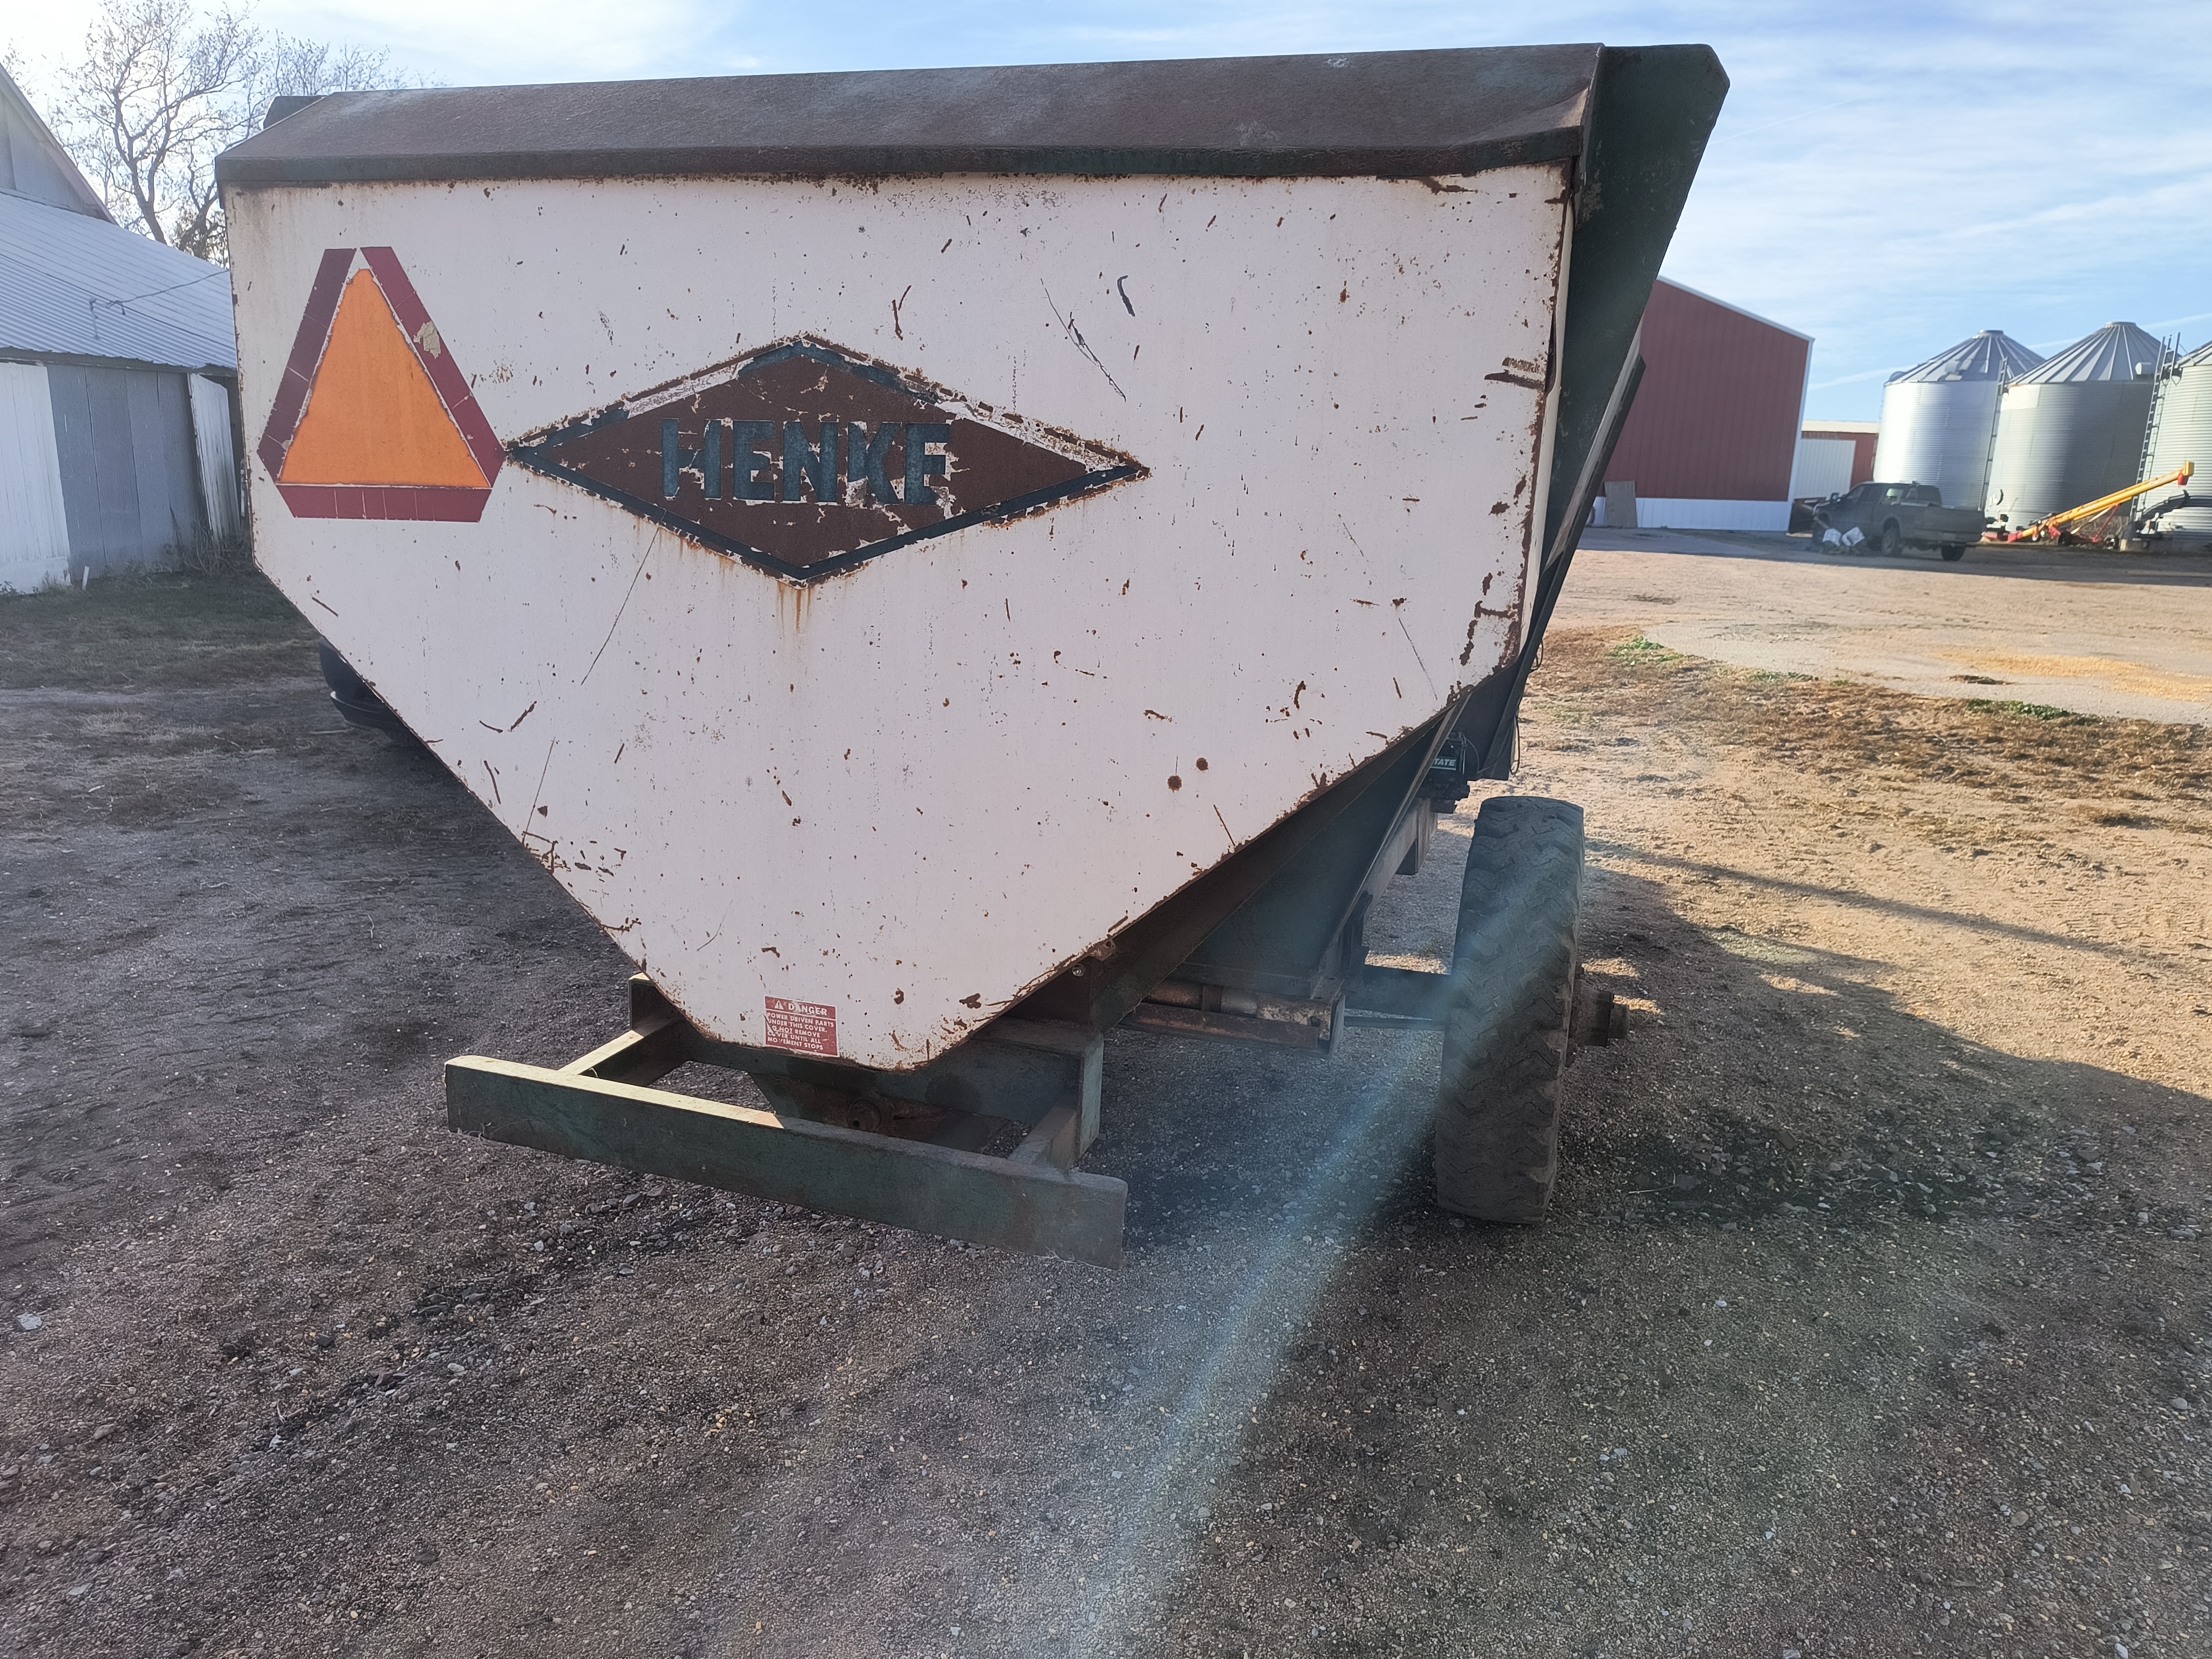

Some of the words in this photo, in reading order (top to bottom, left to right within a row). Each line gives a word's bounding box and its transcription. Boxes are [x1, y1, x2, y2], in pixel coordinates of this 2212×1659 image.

[661, 419, 951, 505] HENKE
[1434, 758, 1456, 766] TATE
[788, 1003, 827, 1015] DANGER
[767, 1012, 788, 1020] POWER
[790, 1015, 813, 1024] DRIVEN
[795, 1029, 820, 1037] REMOVE
[805, 1024, 827, 1033] COVER.
